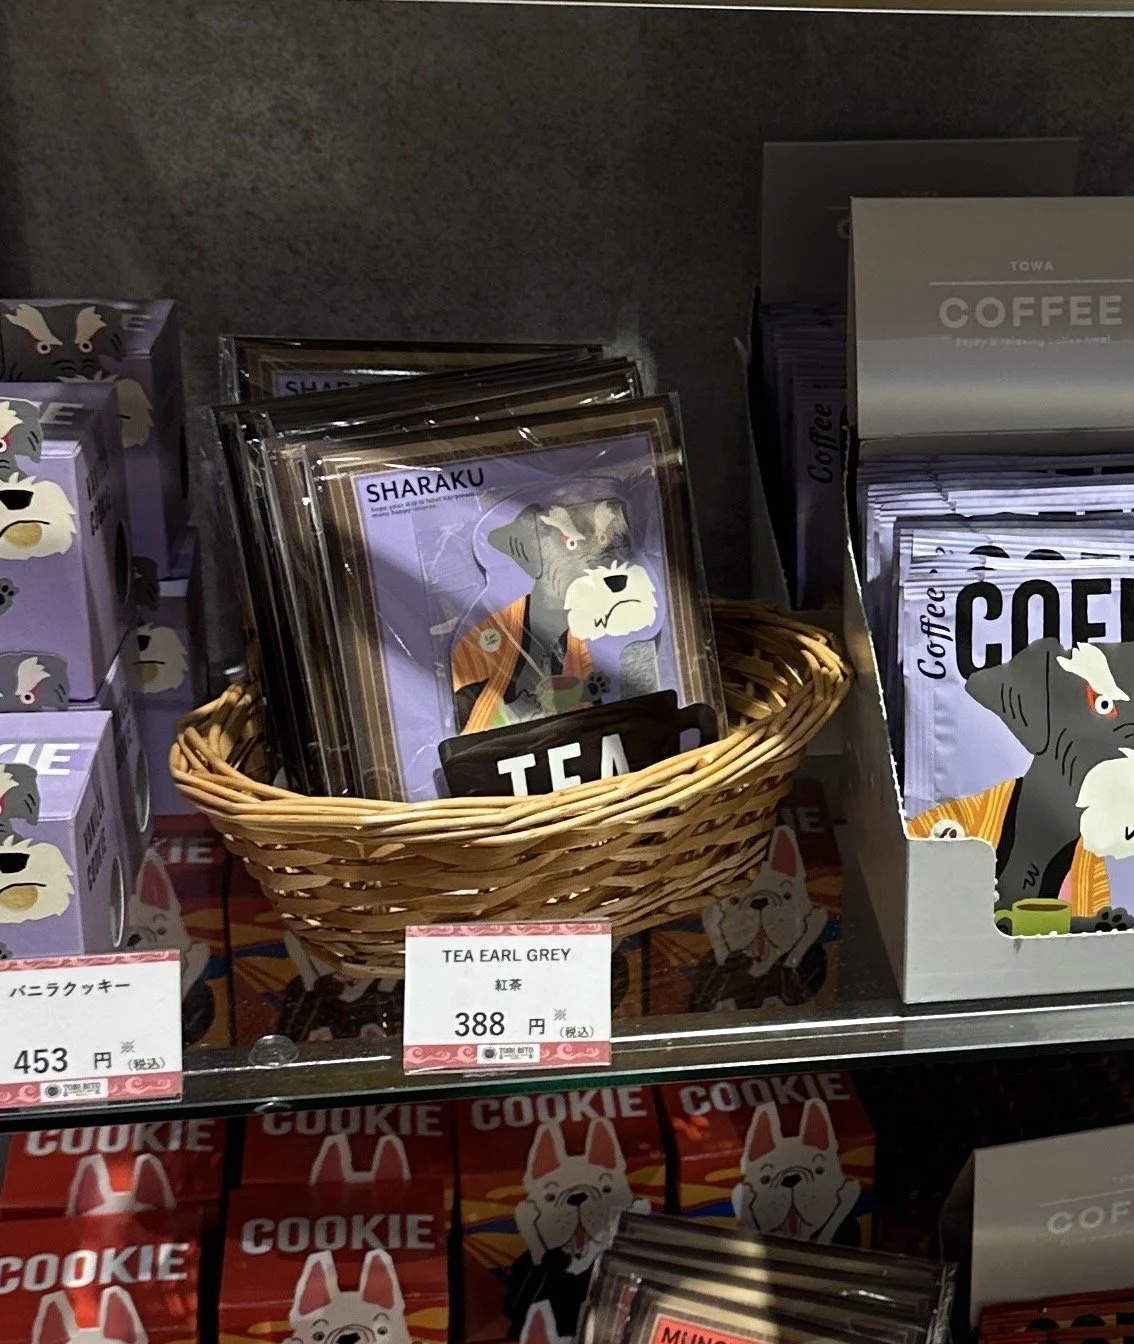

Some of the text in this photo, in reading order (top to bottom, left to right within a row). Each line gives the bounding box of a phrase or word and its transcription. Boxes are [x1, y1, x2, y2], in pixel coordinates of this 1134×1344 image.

[1009, 261, 1054, 272] TOWA
[938, 295, 1122, 329] COFFEE
[806, 402, 834, 486] Coffee
[366, 467, 485, 503] SHARAKU
[916, 586, 947, 680] Coffee
[498, 733, 632, 797] TEA
[442, 948, 571, 963] TEA EARL GREY
[9, 979, 130, 998] バニラクッキー
[495, 978, 522, 992] 紅茶
[454, 1011, 546, 1036] 388 円
[14, 1047, 112, 1075] 453 円
[471, 1086, 648, 1130] COOKIE
[680, 1072, 851, 1116] COOKIE
[25, 1119, 214, 1156] COOKIE
[262, 1105, 444, 1137] COOKIE
[241, 1213, 436, 1255] COOKIE
[0, 1242, 190, 1296] COOKIE
